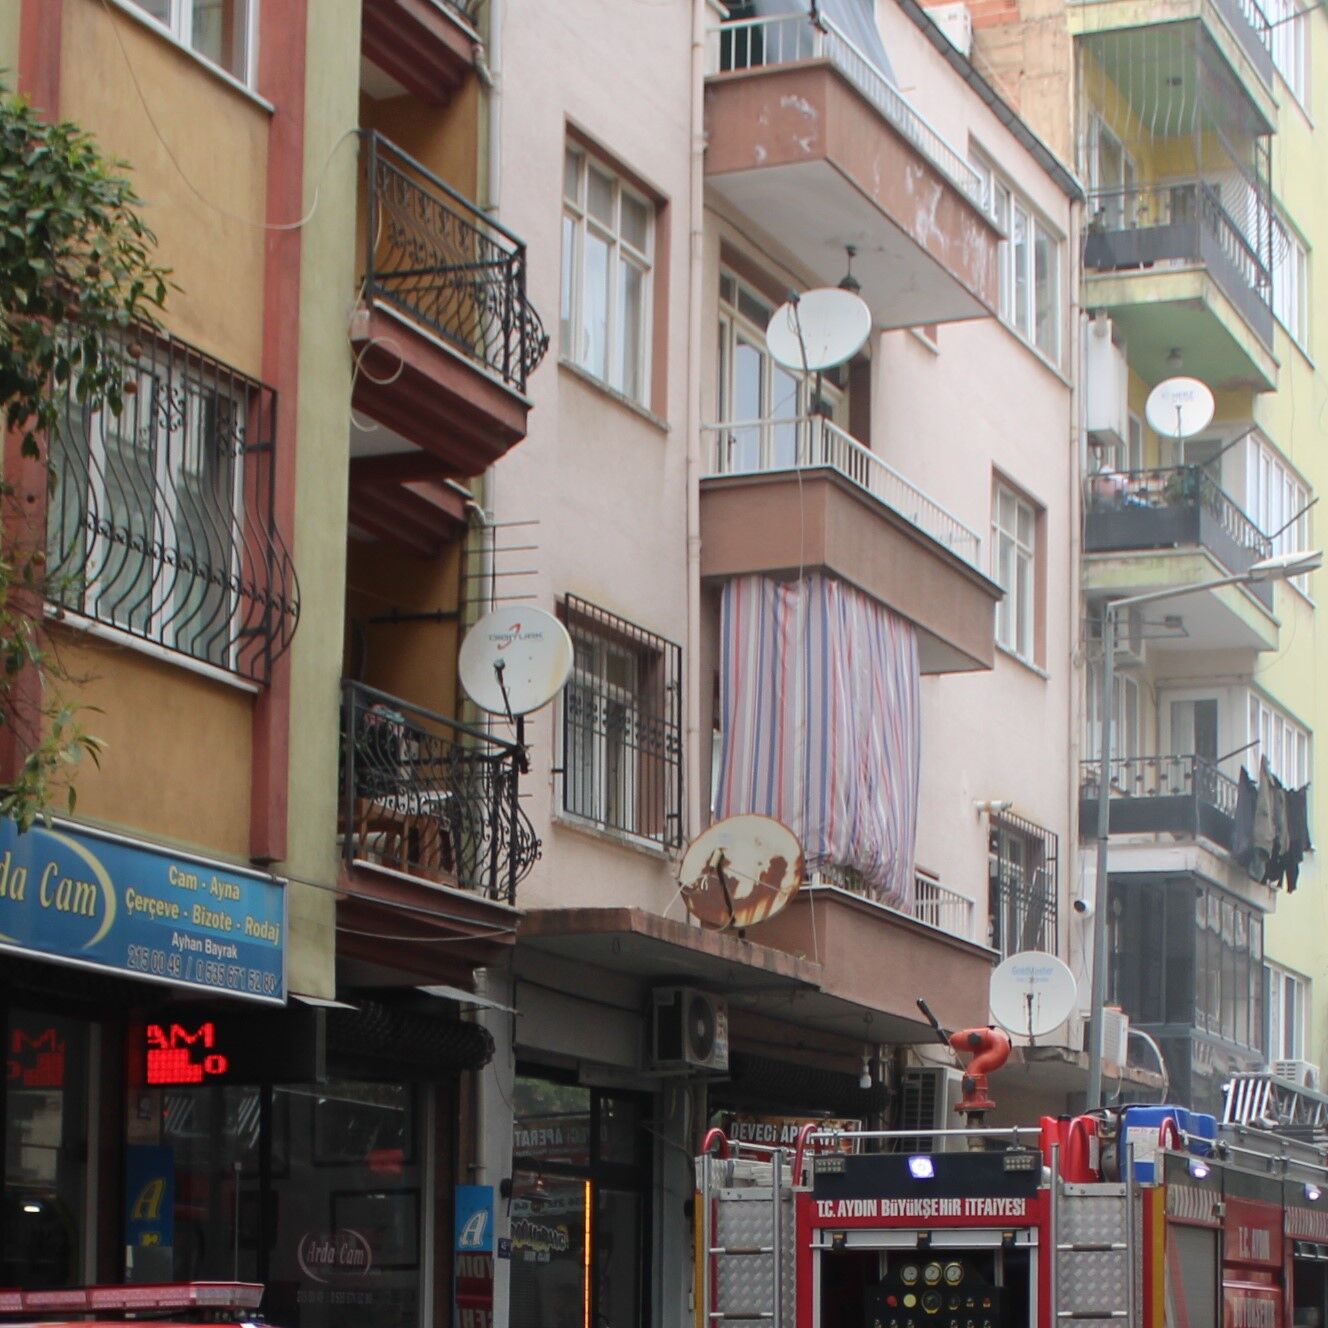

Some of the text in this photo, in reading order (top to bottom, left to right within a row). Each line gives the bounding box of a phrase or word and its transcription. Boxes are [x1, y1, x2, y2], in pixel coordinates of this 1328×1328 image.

[39, 861, 98, 917] Cam
[168, 865, 198, 891] Cam
[210, 876, 241, 901] Ayna
[125, 888, 180, 921] Çerçeve
[191, 905, 233, 932] Bizote
[244, 915, 281, 946] Rodaj
[172, 931, 238, 960] Ayhan Bayrak
[837, 1200, 878, 1218] AYDIN
